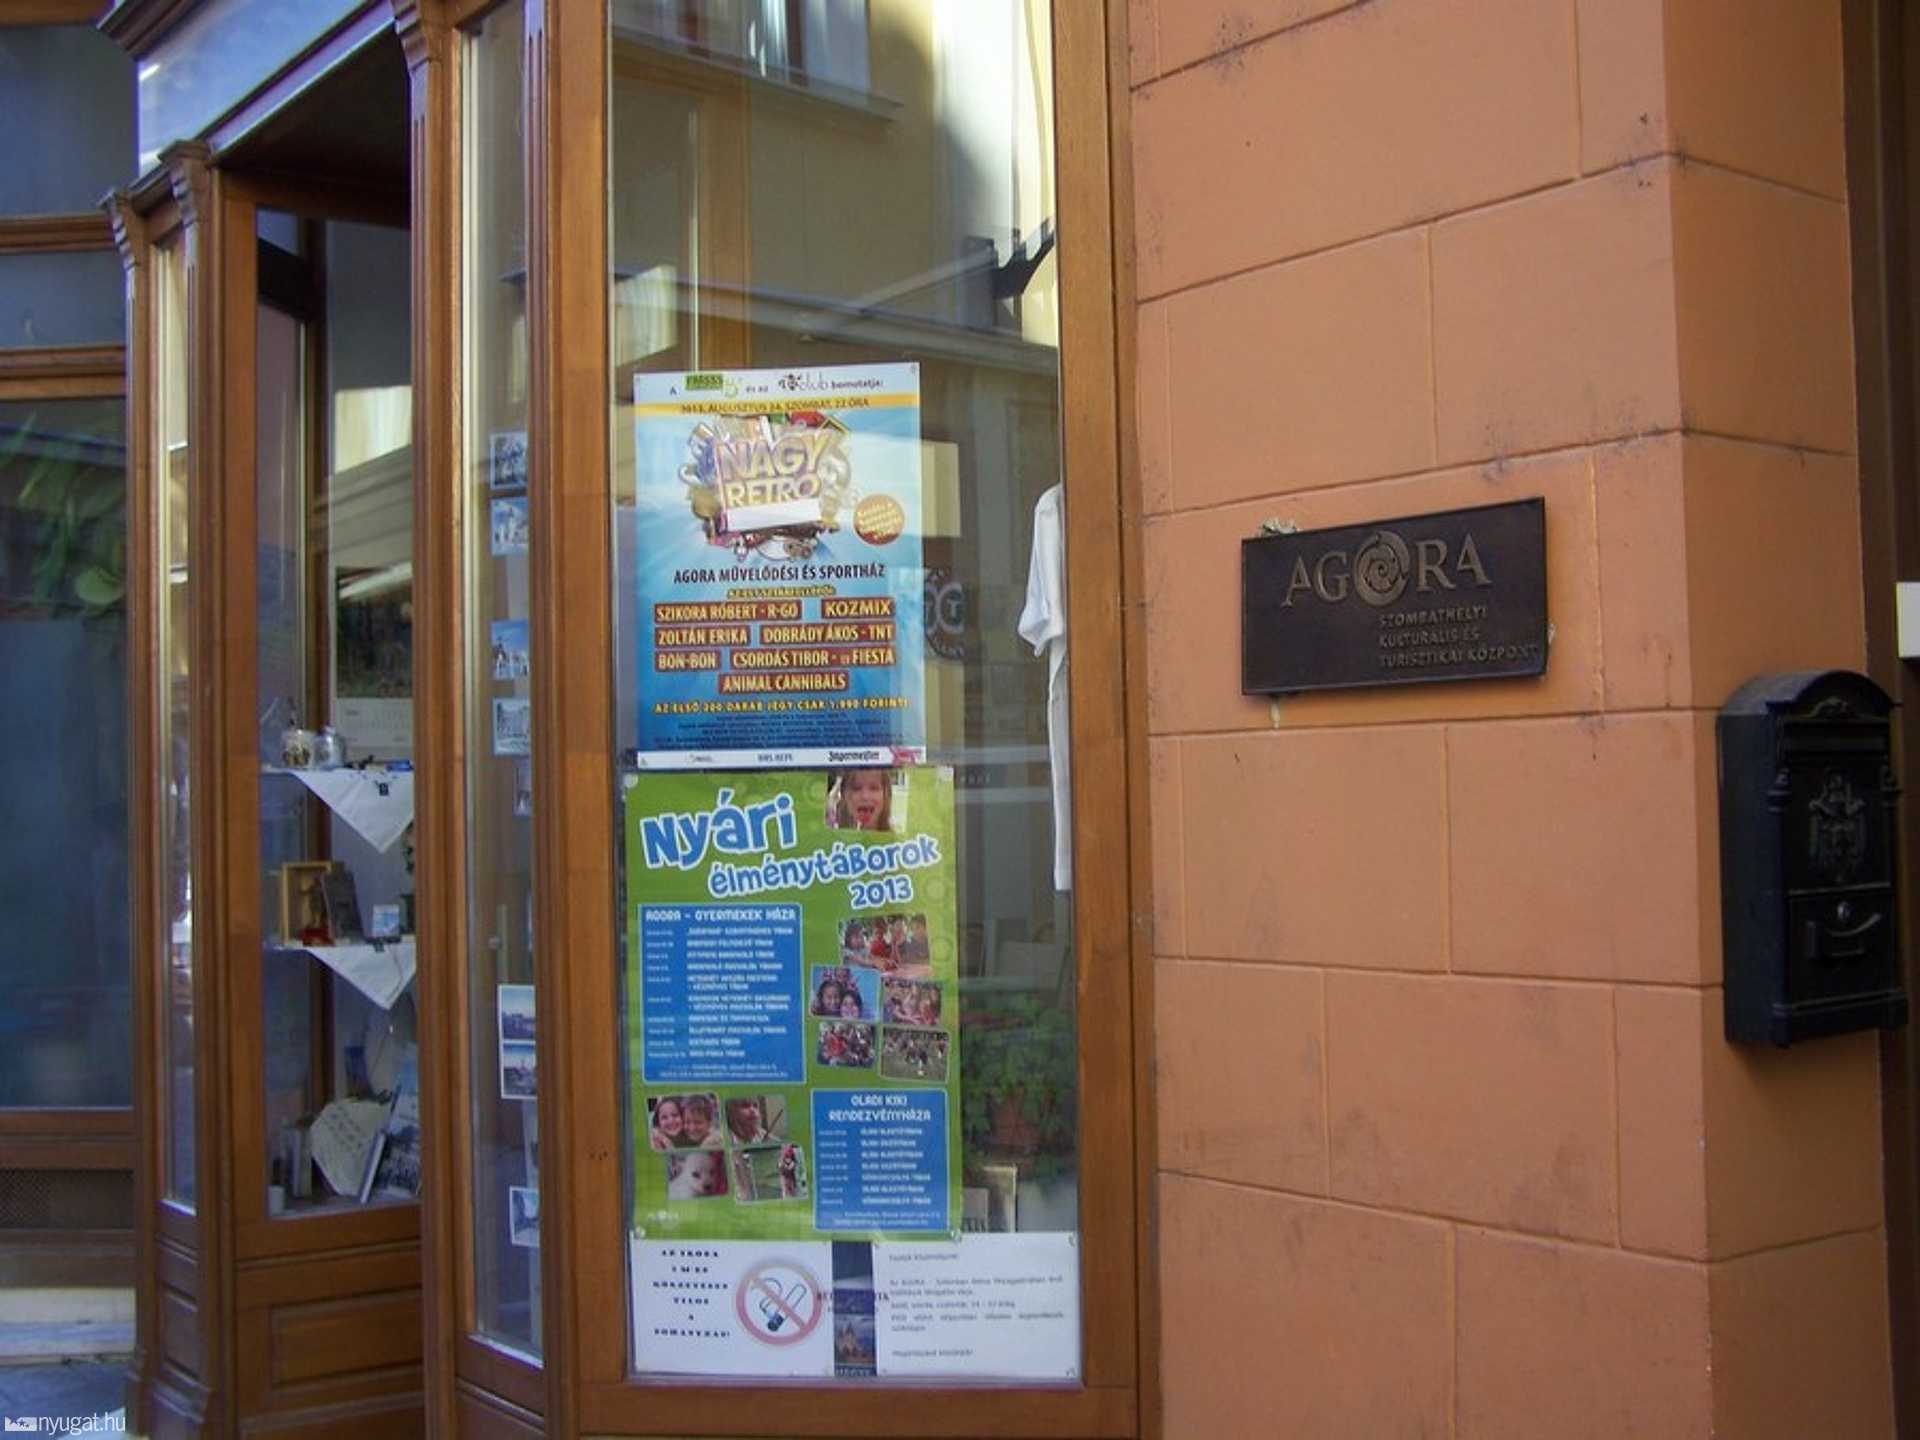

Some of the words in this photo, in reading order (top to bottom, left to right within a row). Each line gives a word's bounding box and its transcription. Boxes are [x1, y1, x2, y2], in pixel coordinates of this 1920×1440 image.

[708, 401, 768, 413] AUGUSZTUS
[716, 432, 831, 478] NAGY
[726, 474, 821, 507] RETRO
[674, 568, 717, 584] AGORA
[719, 565, 799, 583] MŰVELŐDÉSI
[800, 563, 816, 581] ÉS
[818, 562, 886, 579] SPORTHÁZ
[1280, 529, 1493, 608] AGORA
[656, 604, 706, 622] SZIKORA
[709, 601, 757, 620] RÓBERT
[767, 602, 799, 619] R-GO
[824, 598, 891, 618] KOZMIX
[1379, 605, 1488, 628] SZOMBATHELYI
[657, 626, 705, 645] ZOLTÁN
[708, 627, 748, 645] ERIKA
[763, 624, 824, 644] DOBRÁDY
[824, 622, 859, 641] ÁKOS
[868, 623, 894, 641] TNT
[1379, 627, 1459, 649] KULTURÁLIS
[1460, 625, 1481, 643] ÉS
[657, 651, 717, 669] BON-BON
[732, 647, 791, 668] CSORDÁS
[791, 649, 830, 667] TIBOR
[851, 647, 895, 665] FIESTA
[1379, 648, 1466, 669] TURISZTIKAI
[1467, 642, 1540, 663] KÖZPONT
[722, 673, 773, 692] ANIMAL
[774, 671, 847, 690] CANNIBALS
[798, 699, 827, 711] CSAK
[641, 789, 797, 869] Nyári
[850, 876, 913, 909] 2013
[694, 908, 764, 921] GYERMEKEK
[765, 906, 797, 921] HÁZA
